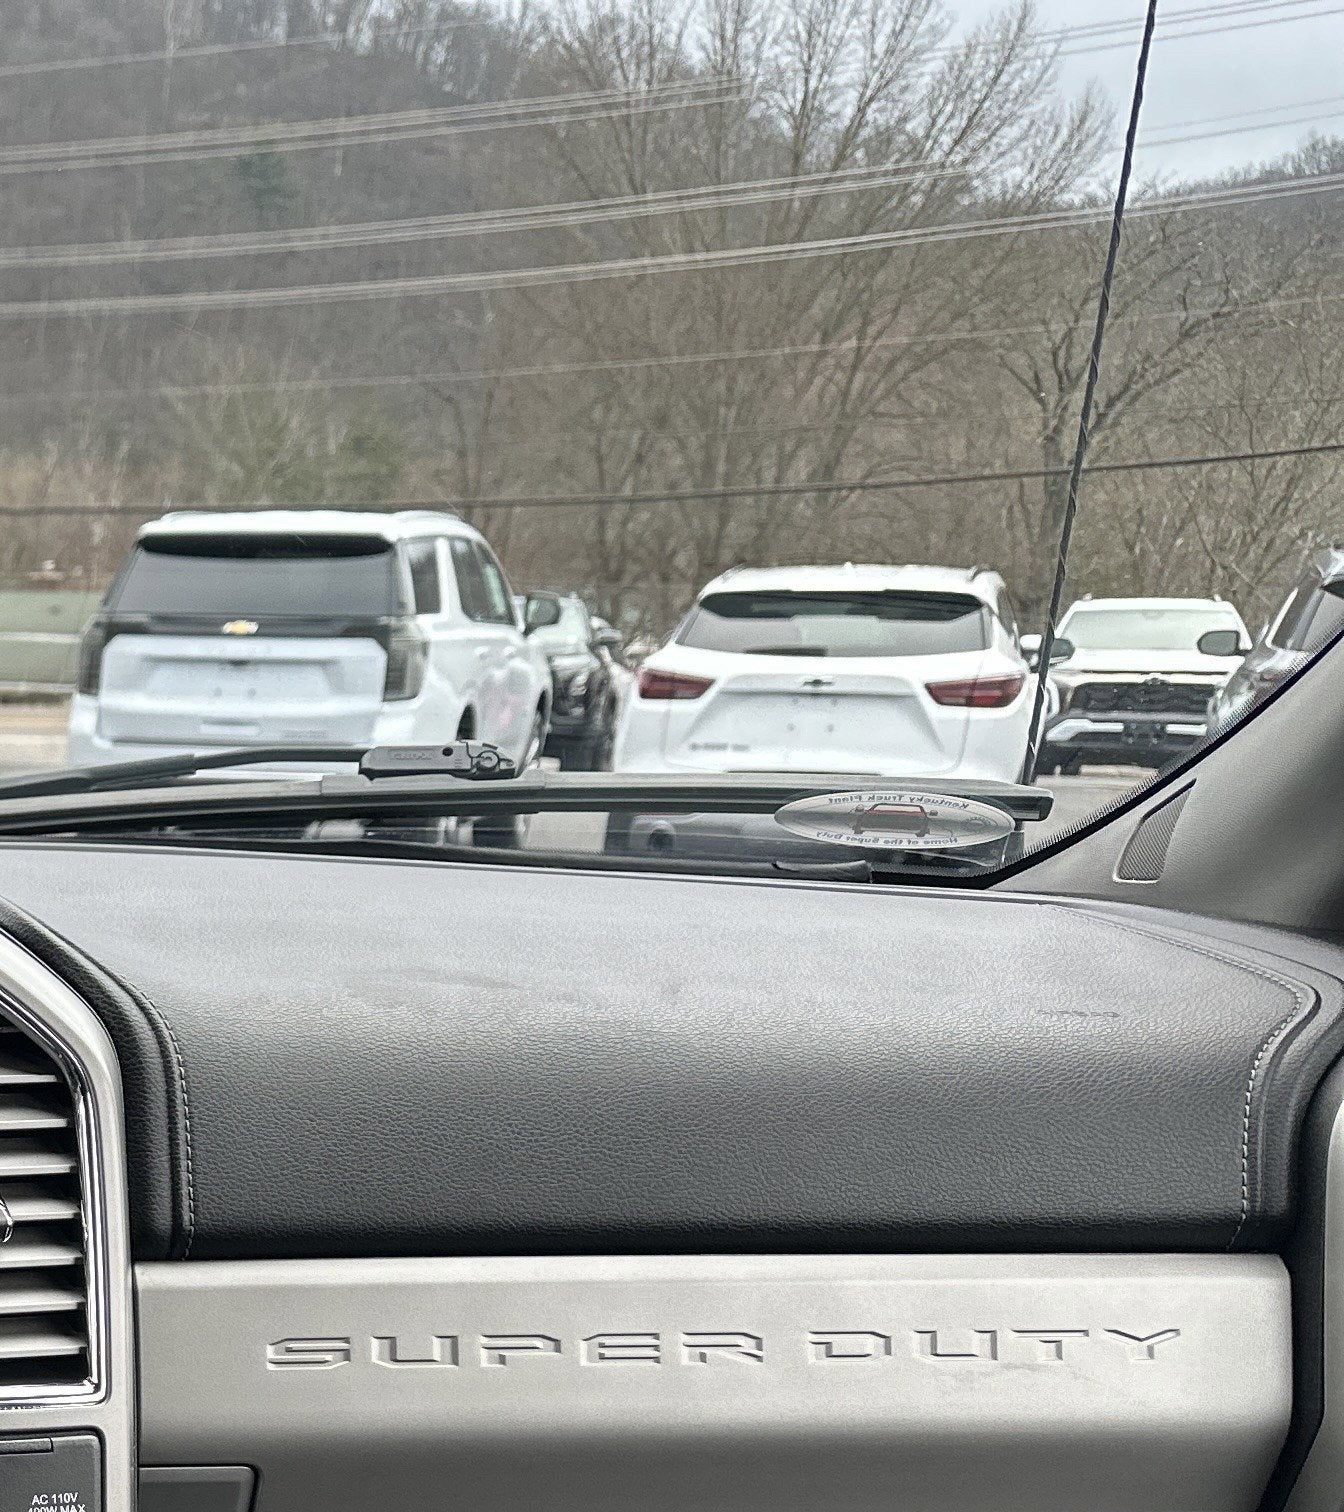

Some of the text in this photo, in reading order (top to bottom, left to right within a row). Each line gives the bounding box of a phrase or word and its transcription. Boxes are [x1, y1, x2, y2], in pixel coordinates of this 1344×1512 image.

[266, 1328, 1183, 1371] SUPER DUTY
[31, 1491, 79, 1506] AC 110V
